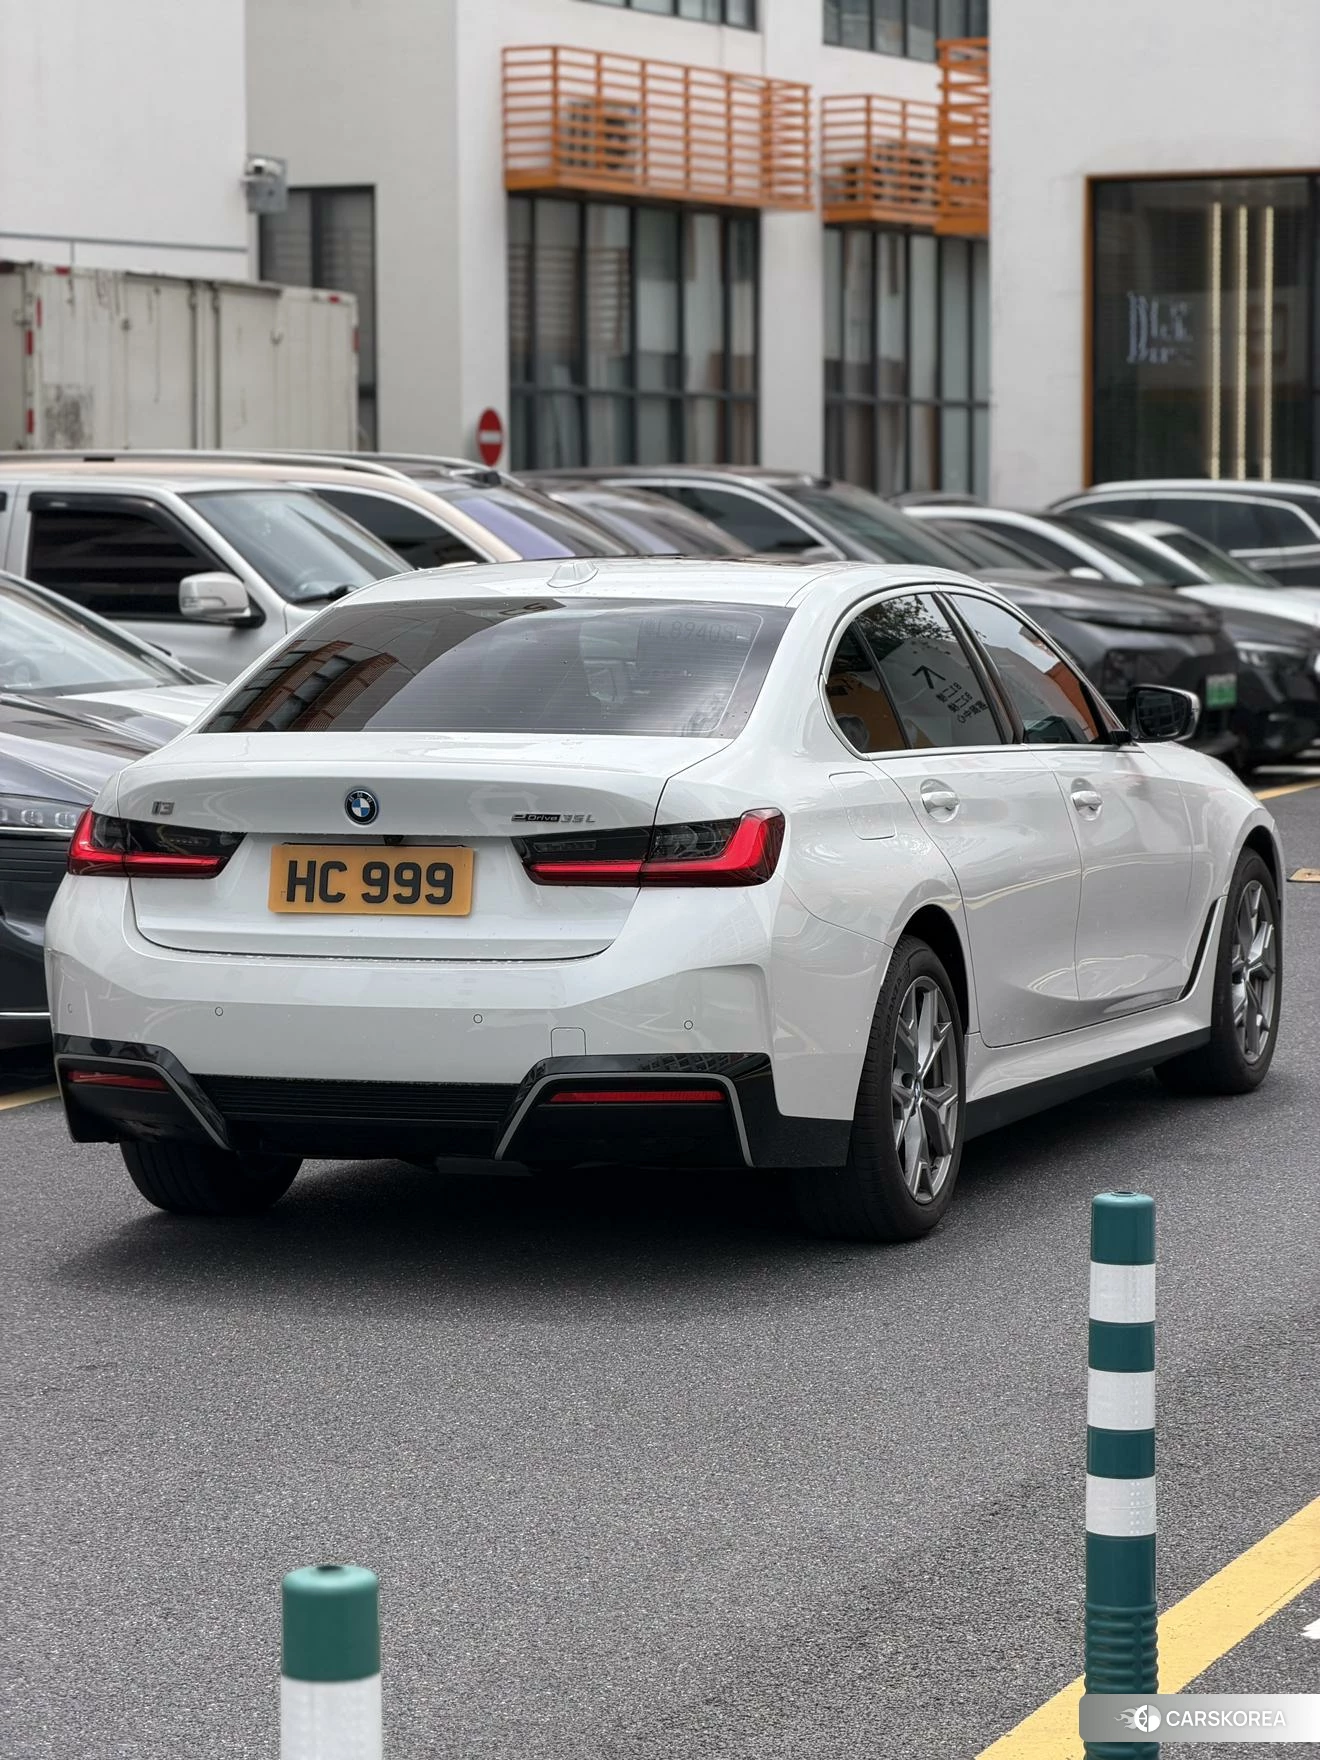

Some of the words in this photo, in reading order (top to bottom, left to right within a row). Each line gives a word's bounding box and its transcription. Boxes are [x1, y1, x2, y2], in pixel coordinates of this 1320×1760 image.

[560, 814, 596, 823] 35L
[286, 859, 348, 904] HC
[361, 861, 454, 905] 999
